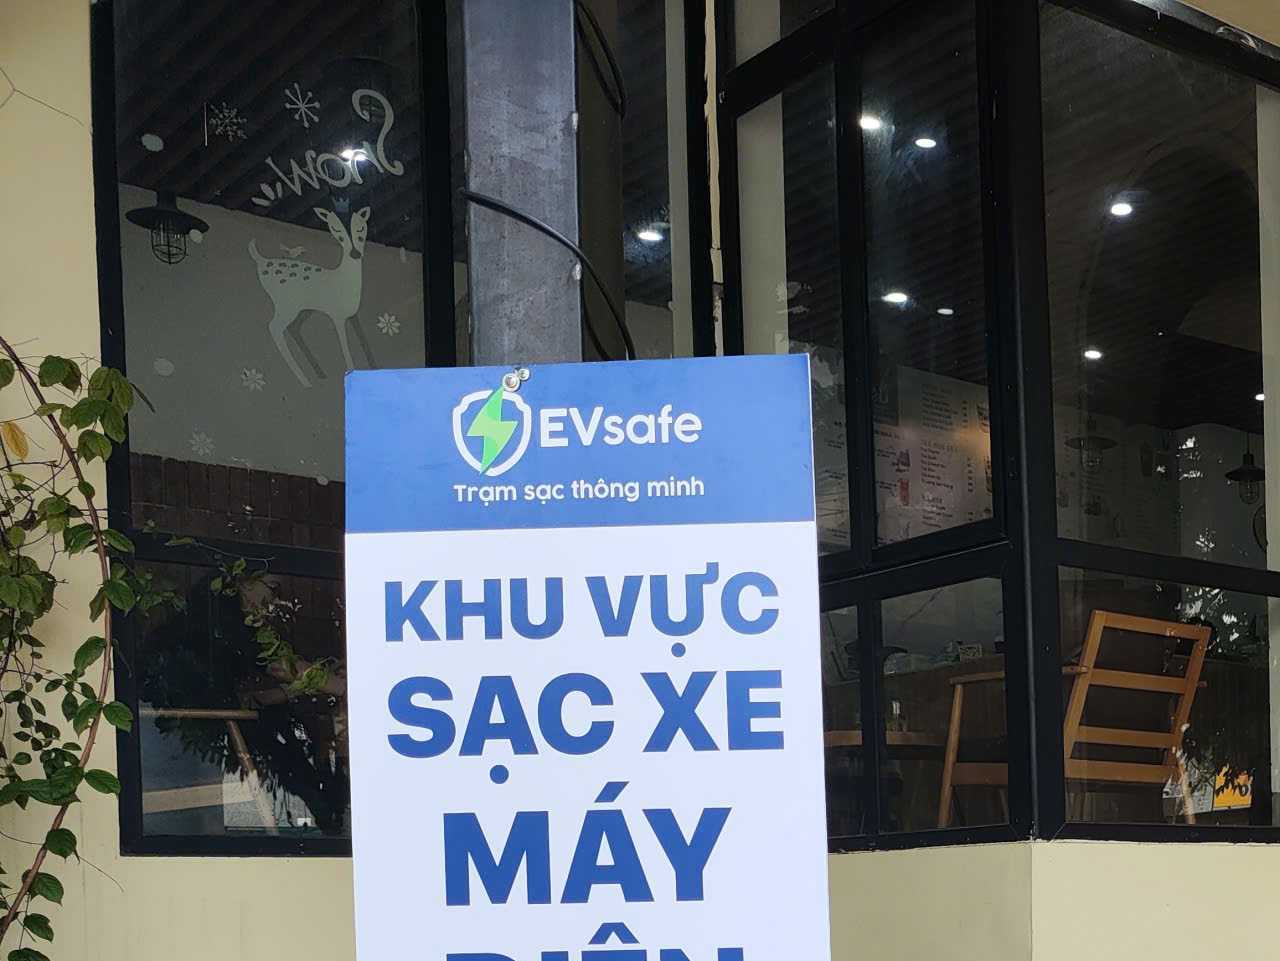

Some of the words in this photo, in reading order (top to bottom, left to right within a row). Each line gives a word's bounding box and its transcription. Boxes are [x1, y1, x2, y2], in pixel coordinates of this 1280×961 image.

[540, 404, 702, 447] EVsafe
[454, 484, 517, 506] Trạm
[524, 483, 564, 505] sạc
[571, 478, 639, 501] thông
[647, 476, 705, 497] minh
[385, 577, 564, 642] KHU
[586, 562, 780, 658] VỰC
[387, 673, 615, 784] SẠC
[640, 670, 784, 753] XE
[443, 781, 733, 906] MÁY
